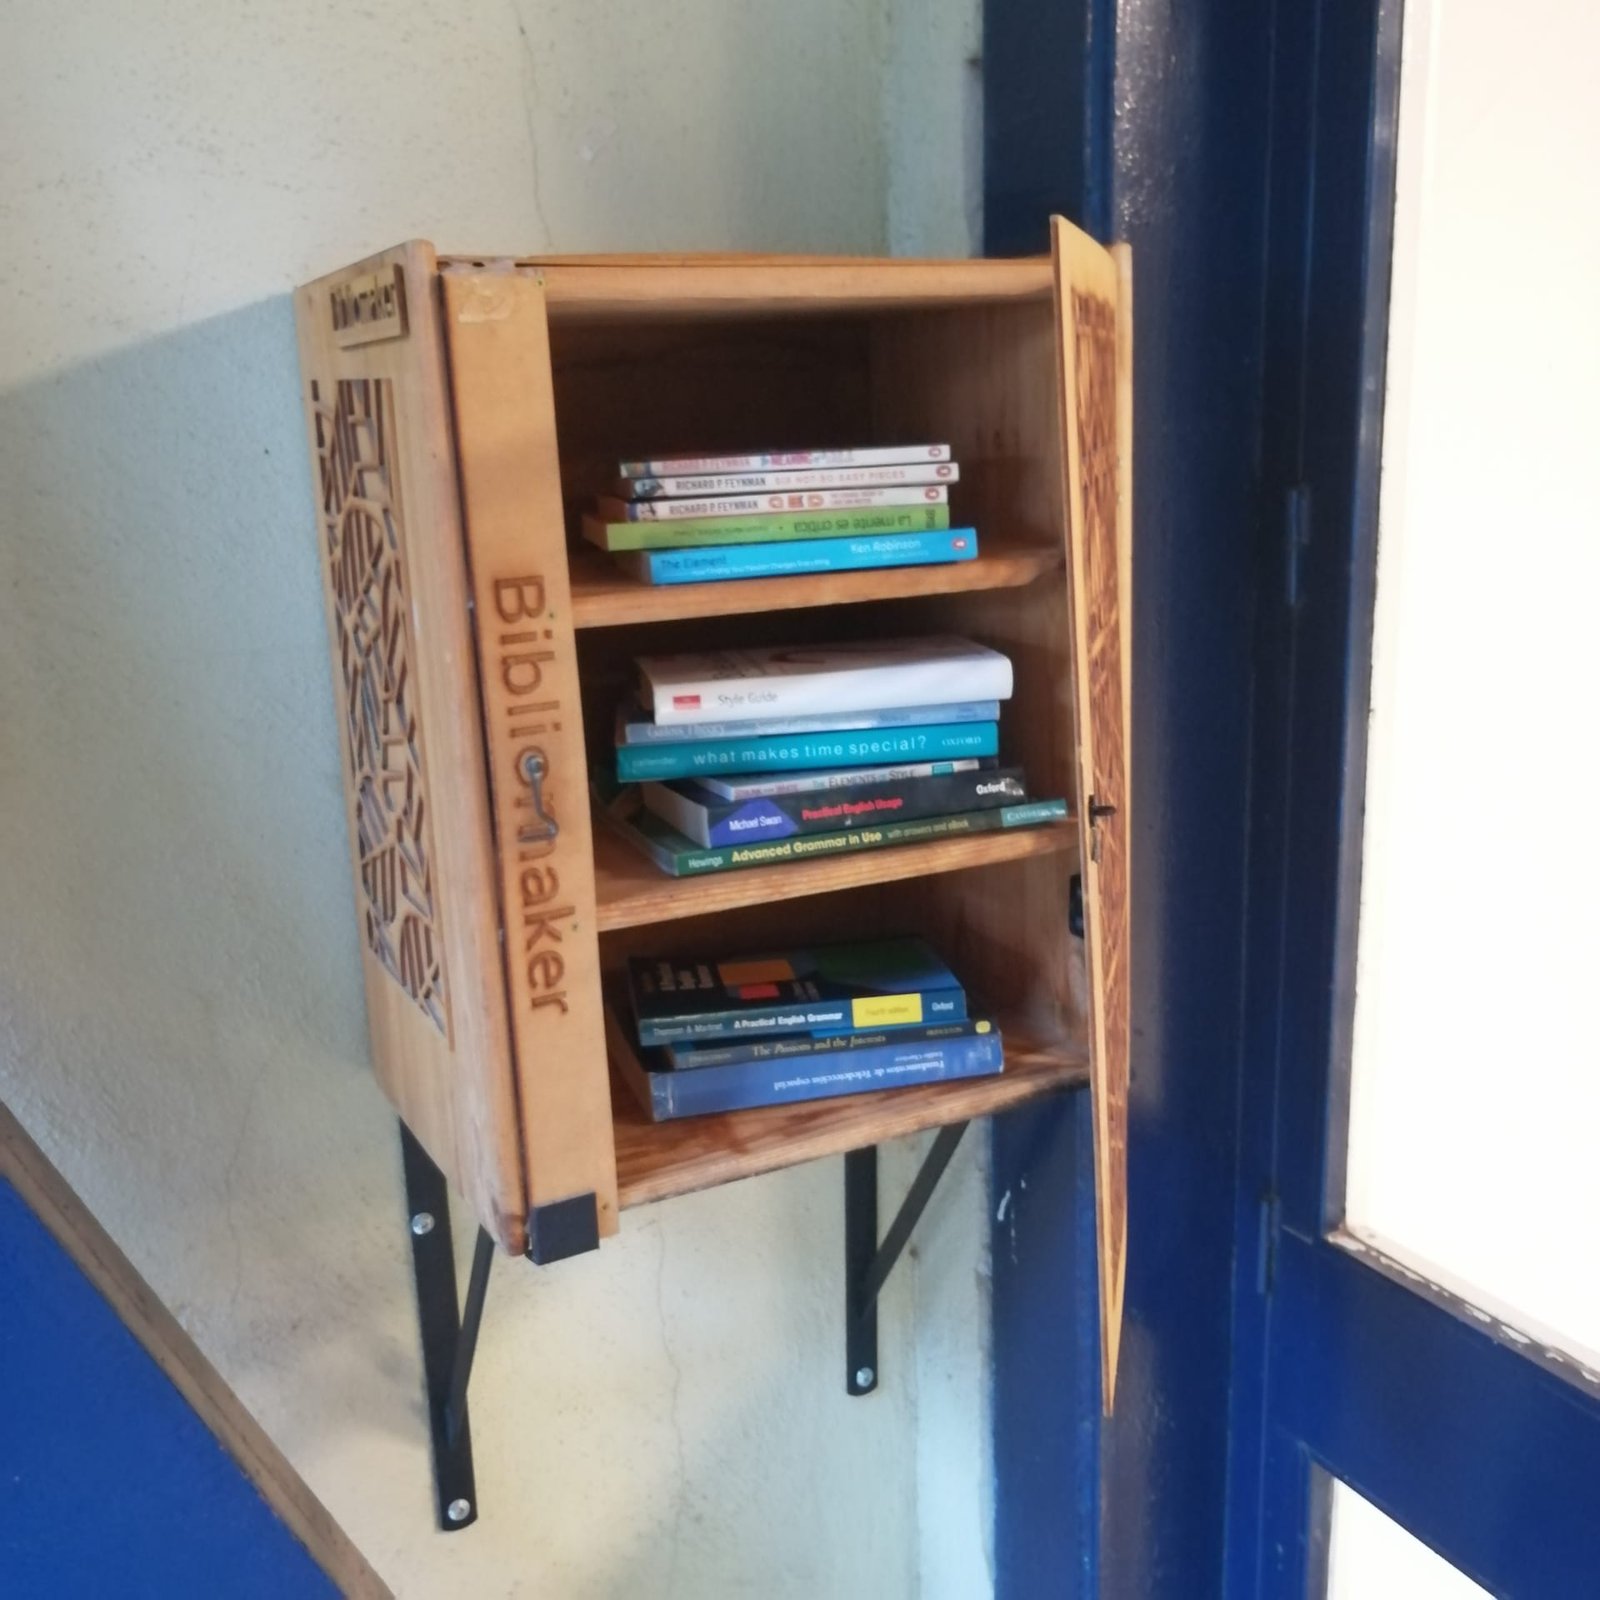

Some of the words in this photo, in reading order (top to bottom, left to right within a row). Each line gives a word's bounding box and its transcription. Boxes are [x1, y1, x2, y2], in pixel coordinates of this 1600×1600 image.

[675, 478, 714, 490] RICHARD
[725, 475, 766, 489] FEYNMAN
[669, 502, 708, 515] RICHARD
[717, 499, 759, 512] FEYNMAN
[851, 542, 871, 553] Ken
[873, 538, 922, 551] Robinson
[660, 558, 680, 570] The
[684, 555, 727, 568] Element
[693, 750, 736, 765] what
[742, 747, 799, 761] makes
[805, 741, 843, 758] time
[849, 735, 928, 756] special?
[942, 735, 982, 747] OXFORD
[493, 574, 577, 1017] Bibliomaker
[976, 781, 1006, 796] Oxford
[729, 817, 758, 831] Michael
[760, 814, 783, 828] Swan
[688, 855, 724, 868] Hewings
[732, 845, 792, 863] Advanced
[793, 835, 847, 853] Grammar
[849, 833, 860, 845] in
[861, 830, 882, 842] Use
[932, 1001, 954, 1012] Oxford
[734, 1020, 741, 1029] A
[742, 1017, 776, 1028] Practical
[777, 1014, 806, 1026] English
[807, 1011, 844, 1023] Grammar
[753, 1044, 770, 1057] The
[814, 1038, 832, 1050] and
[833, 1037, 848, 1049] the
[874, 1067, 885, 1078] de
[886, 1060, 945, 1074] Fundamentos
[773, 1077, 812, 1092] espacial
